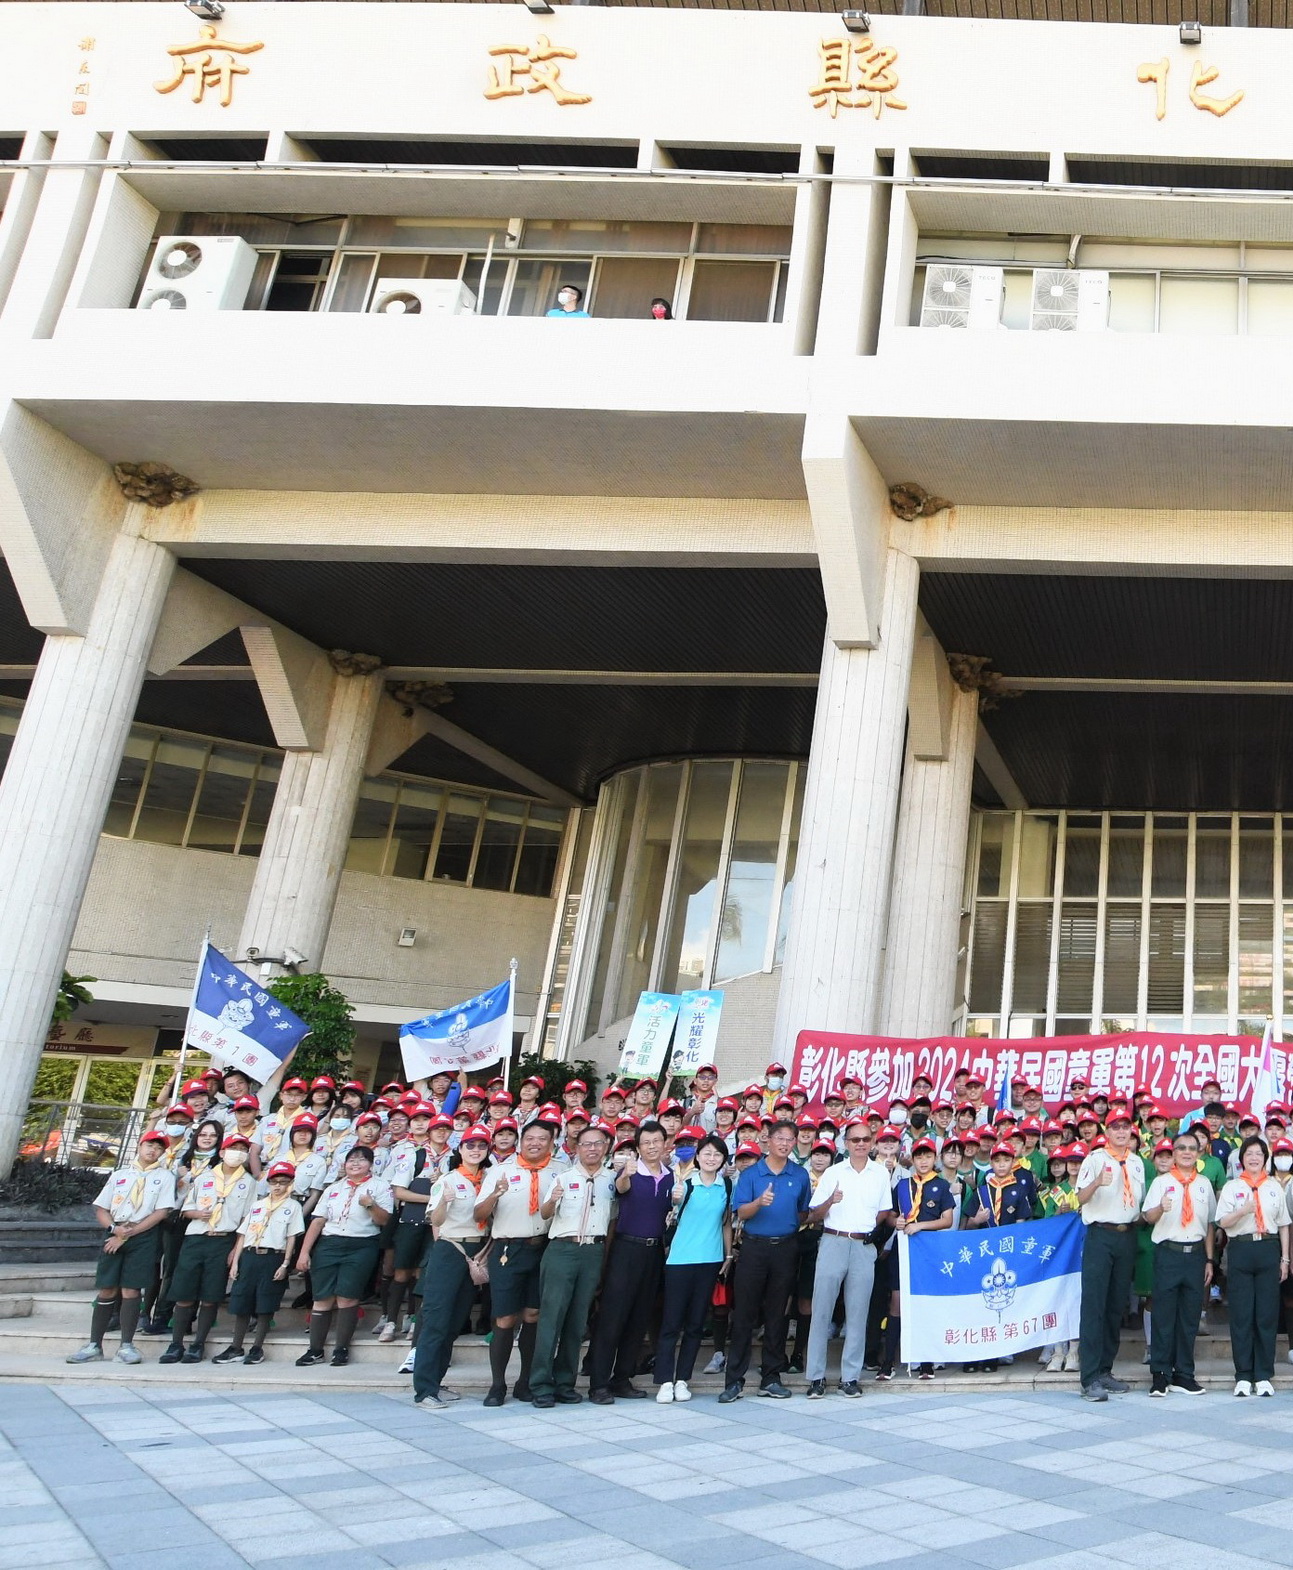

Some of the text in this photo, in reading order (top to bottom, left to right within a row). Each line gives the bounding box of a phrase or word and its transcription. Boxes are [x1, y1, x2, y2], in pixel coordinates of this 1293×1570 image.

[635, 1015, 661, 1066] 活力童軍
[686, 1012, 706, 1063] 光耀彰化
[940, 1235, 1055, 1278] 中華民國童軍
